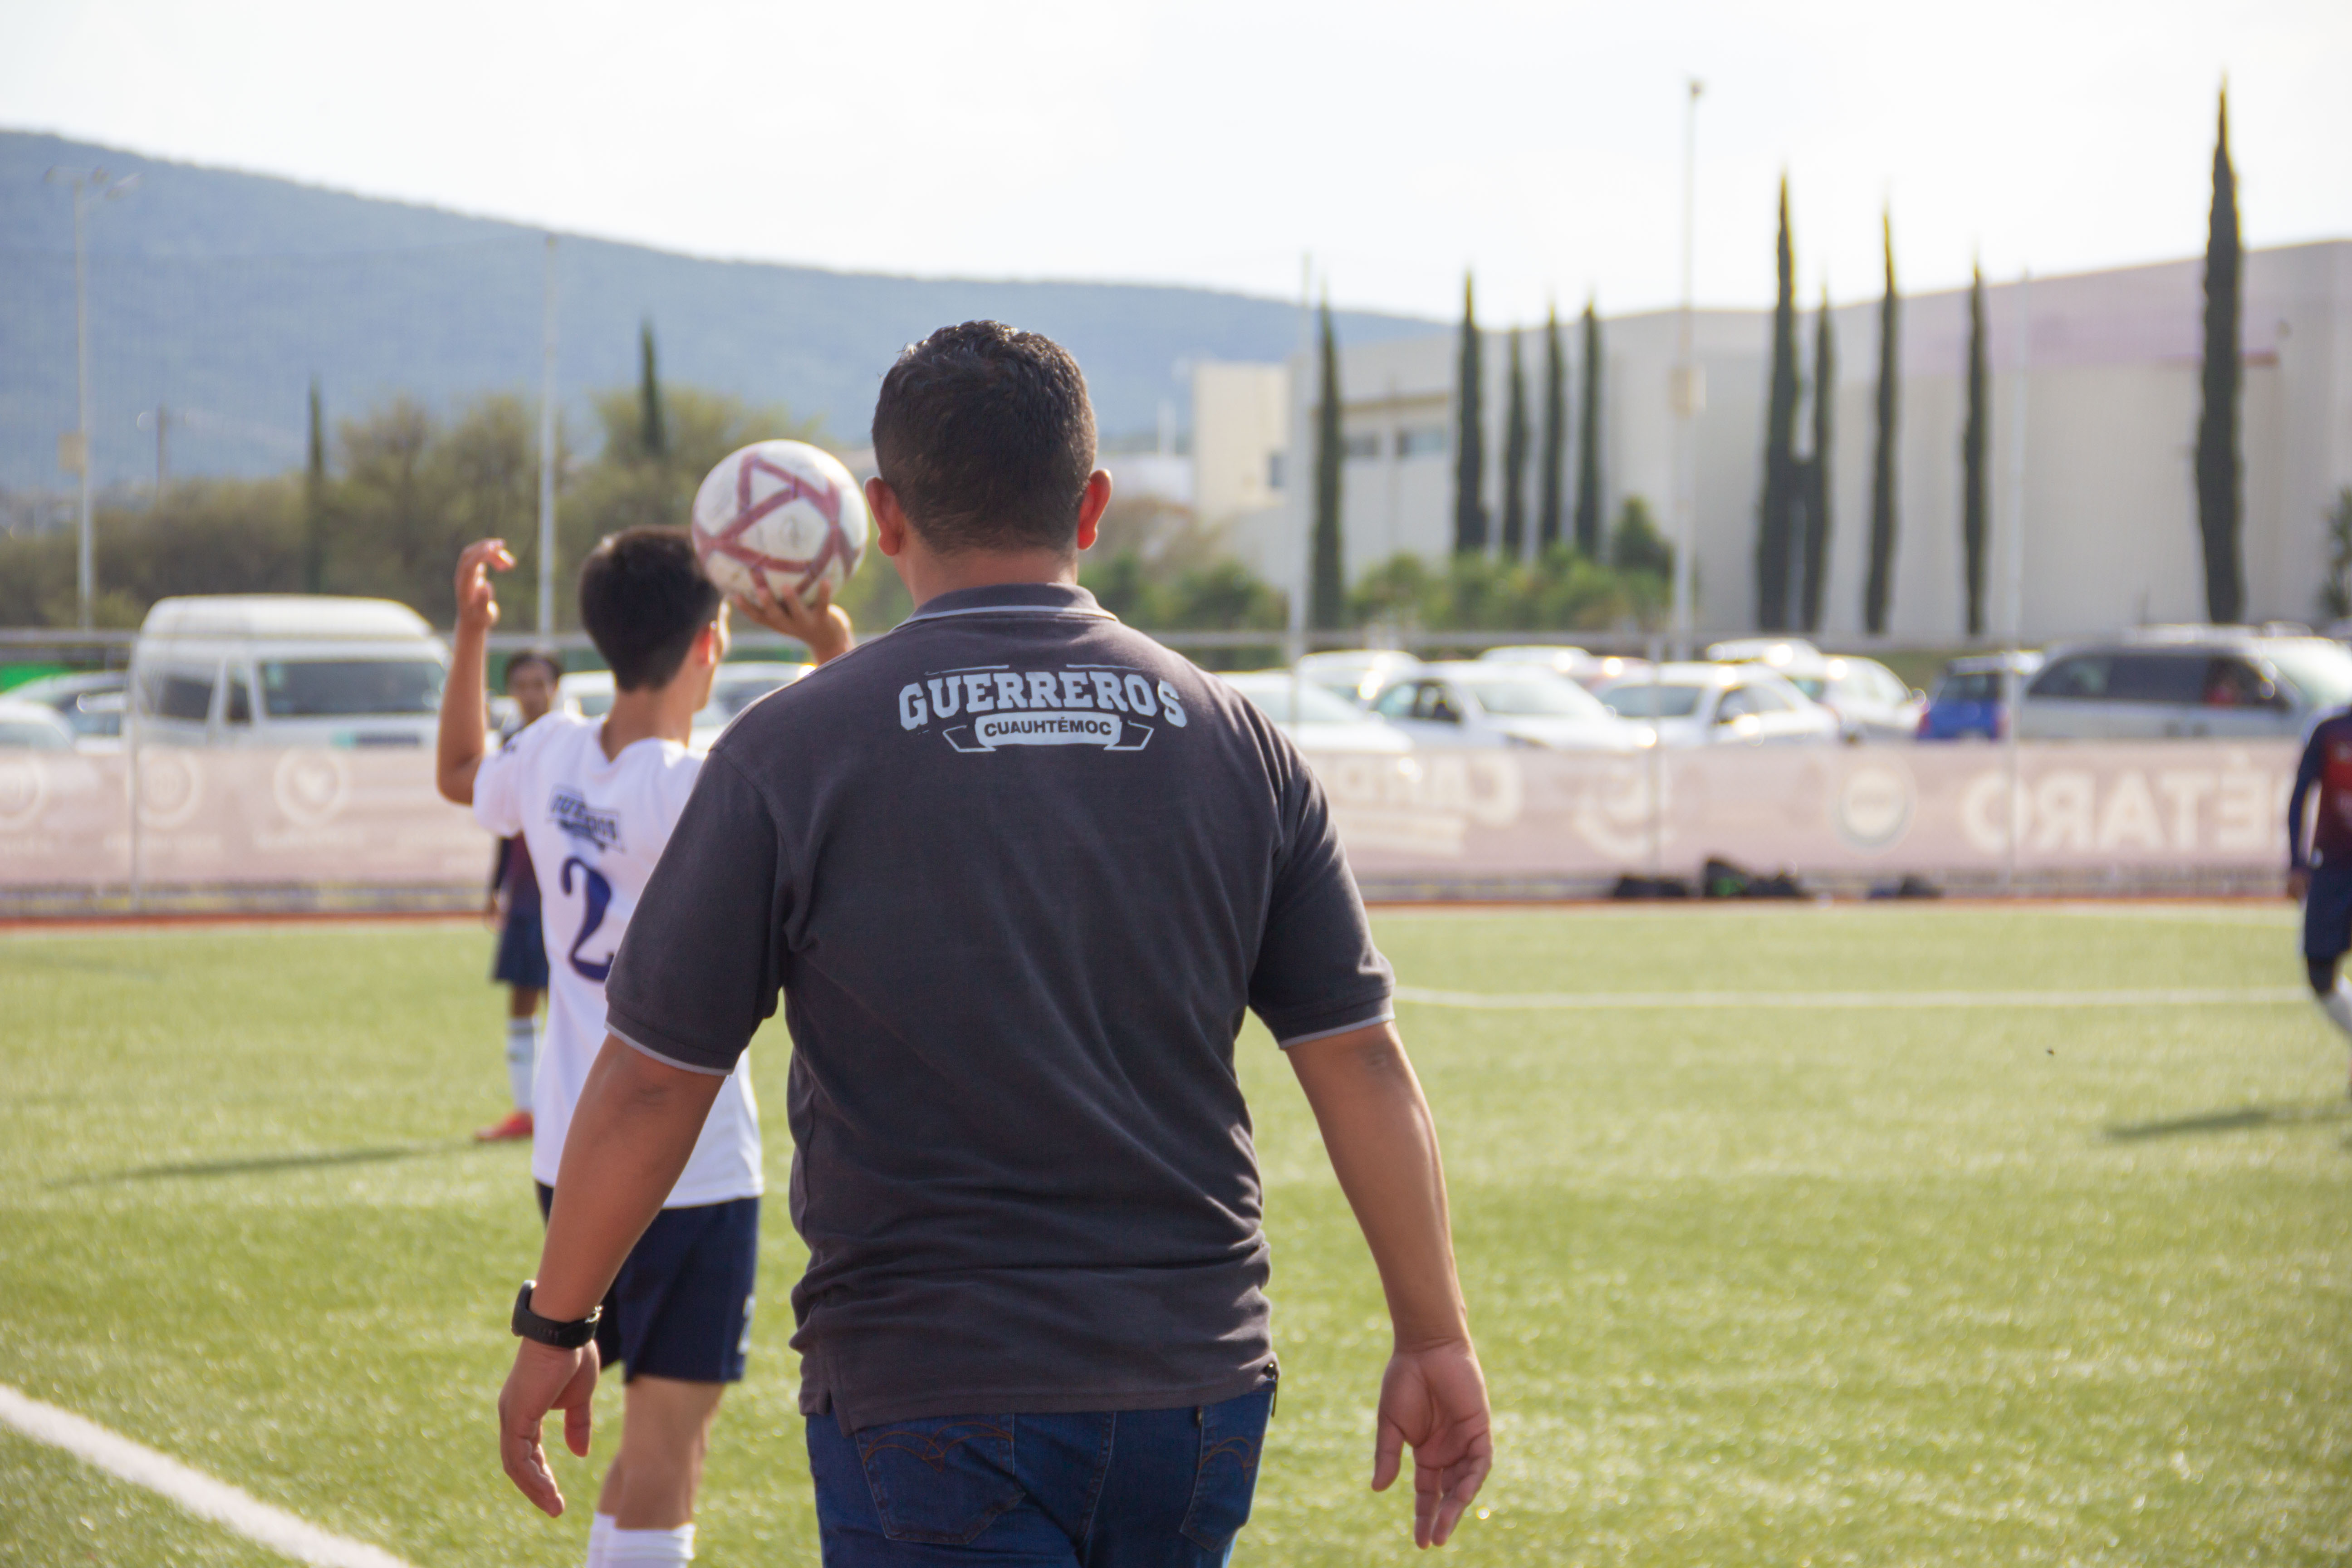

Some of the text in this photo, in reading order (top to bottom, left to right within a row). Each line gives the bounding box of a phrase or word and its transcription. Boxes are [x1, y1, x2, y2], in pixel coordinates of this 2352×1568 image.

[899, 671, 1187, 730] GUERREROS
[984, 716, 1112, 736] CUAUHTÉMOC
[560, 855, 615, 983] 2
